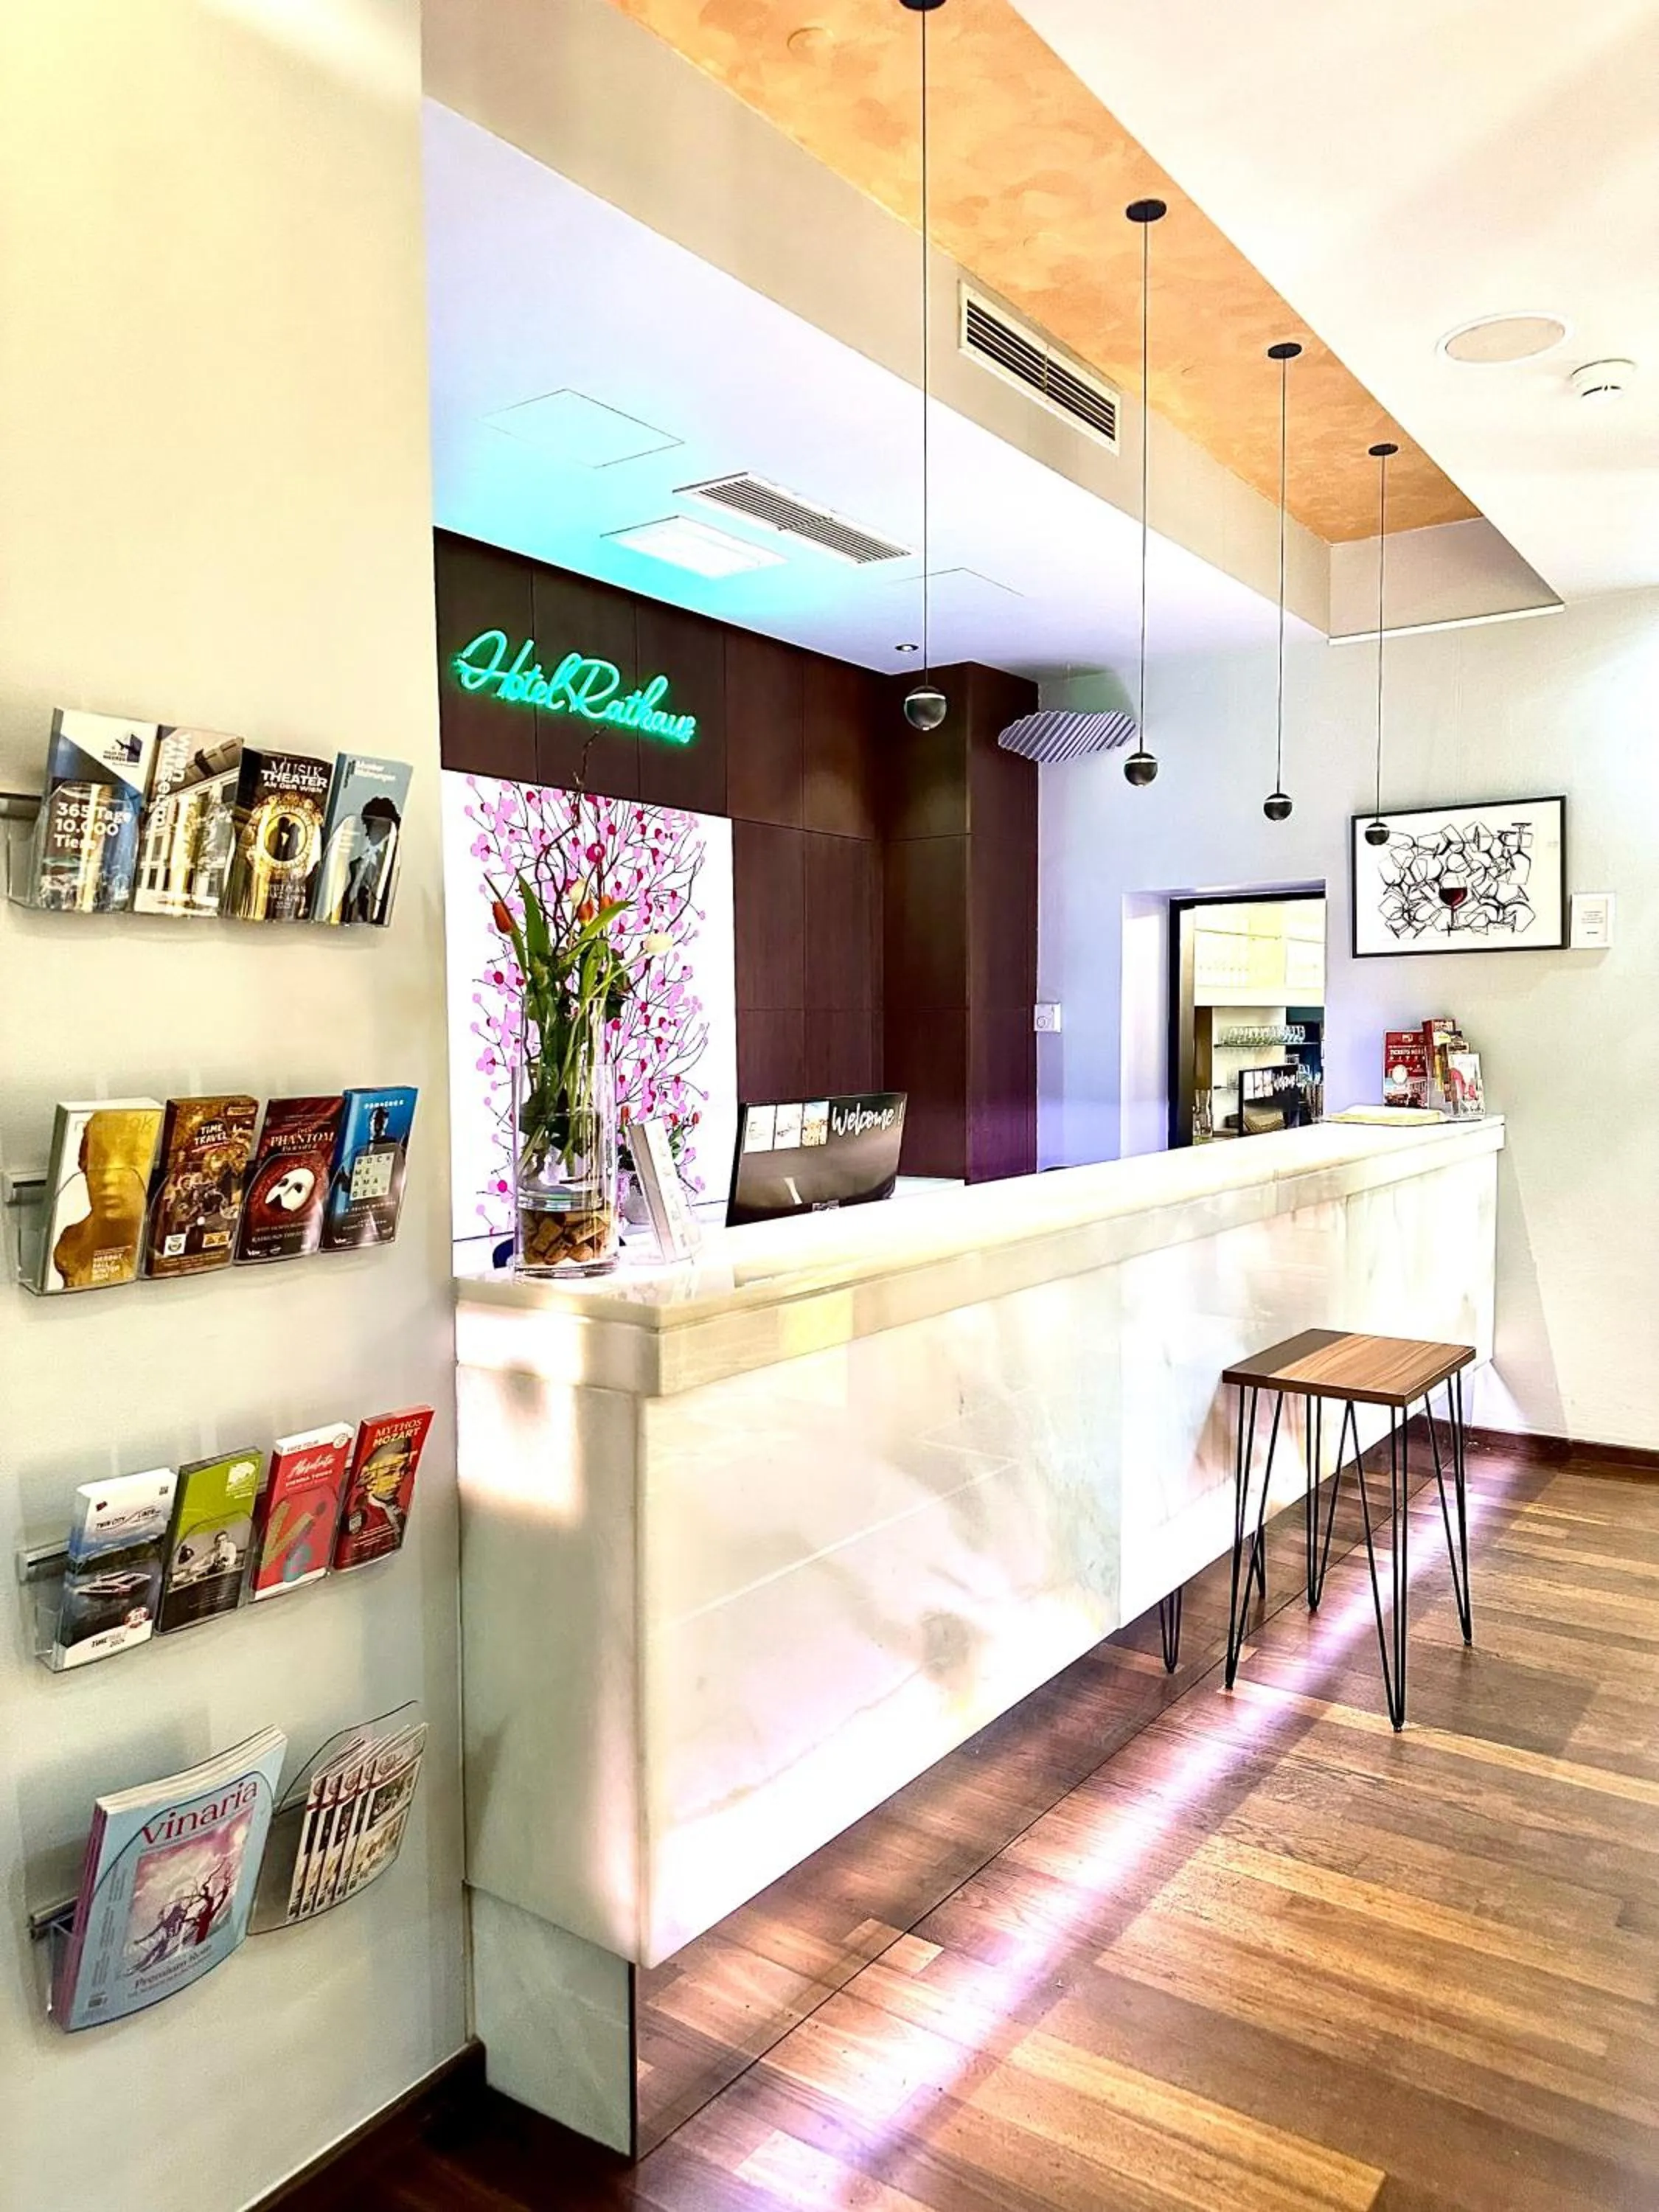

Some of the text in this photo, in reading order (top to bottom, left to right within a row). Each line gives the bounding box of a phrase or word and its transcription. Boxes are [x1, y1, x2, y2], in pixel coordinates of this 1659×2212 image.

[454, 630, 697, 744] Hotel Rathaus
[260, 769, 328, 788] THEATER
[271, 758, 323, 779] MUSIK
[55, 818, 119, 837] 10.000
[831, 1102, 894, 1136] Welcome
[271, 1132, 334, 1147] PHANTOM
[372, 1427, 421, 1448] MOZART
[375, 1418, 423, 1439] MYTHOS
